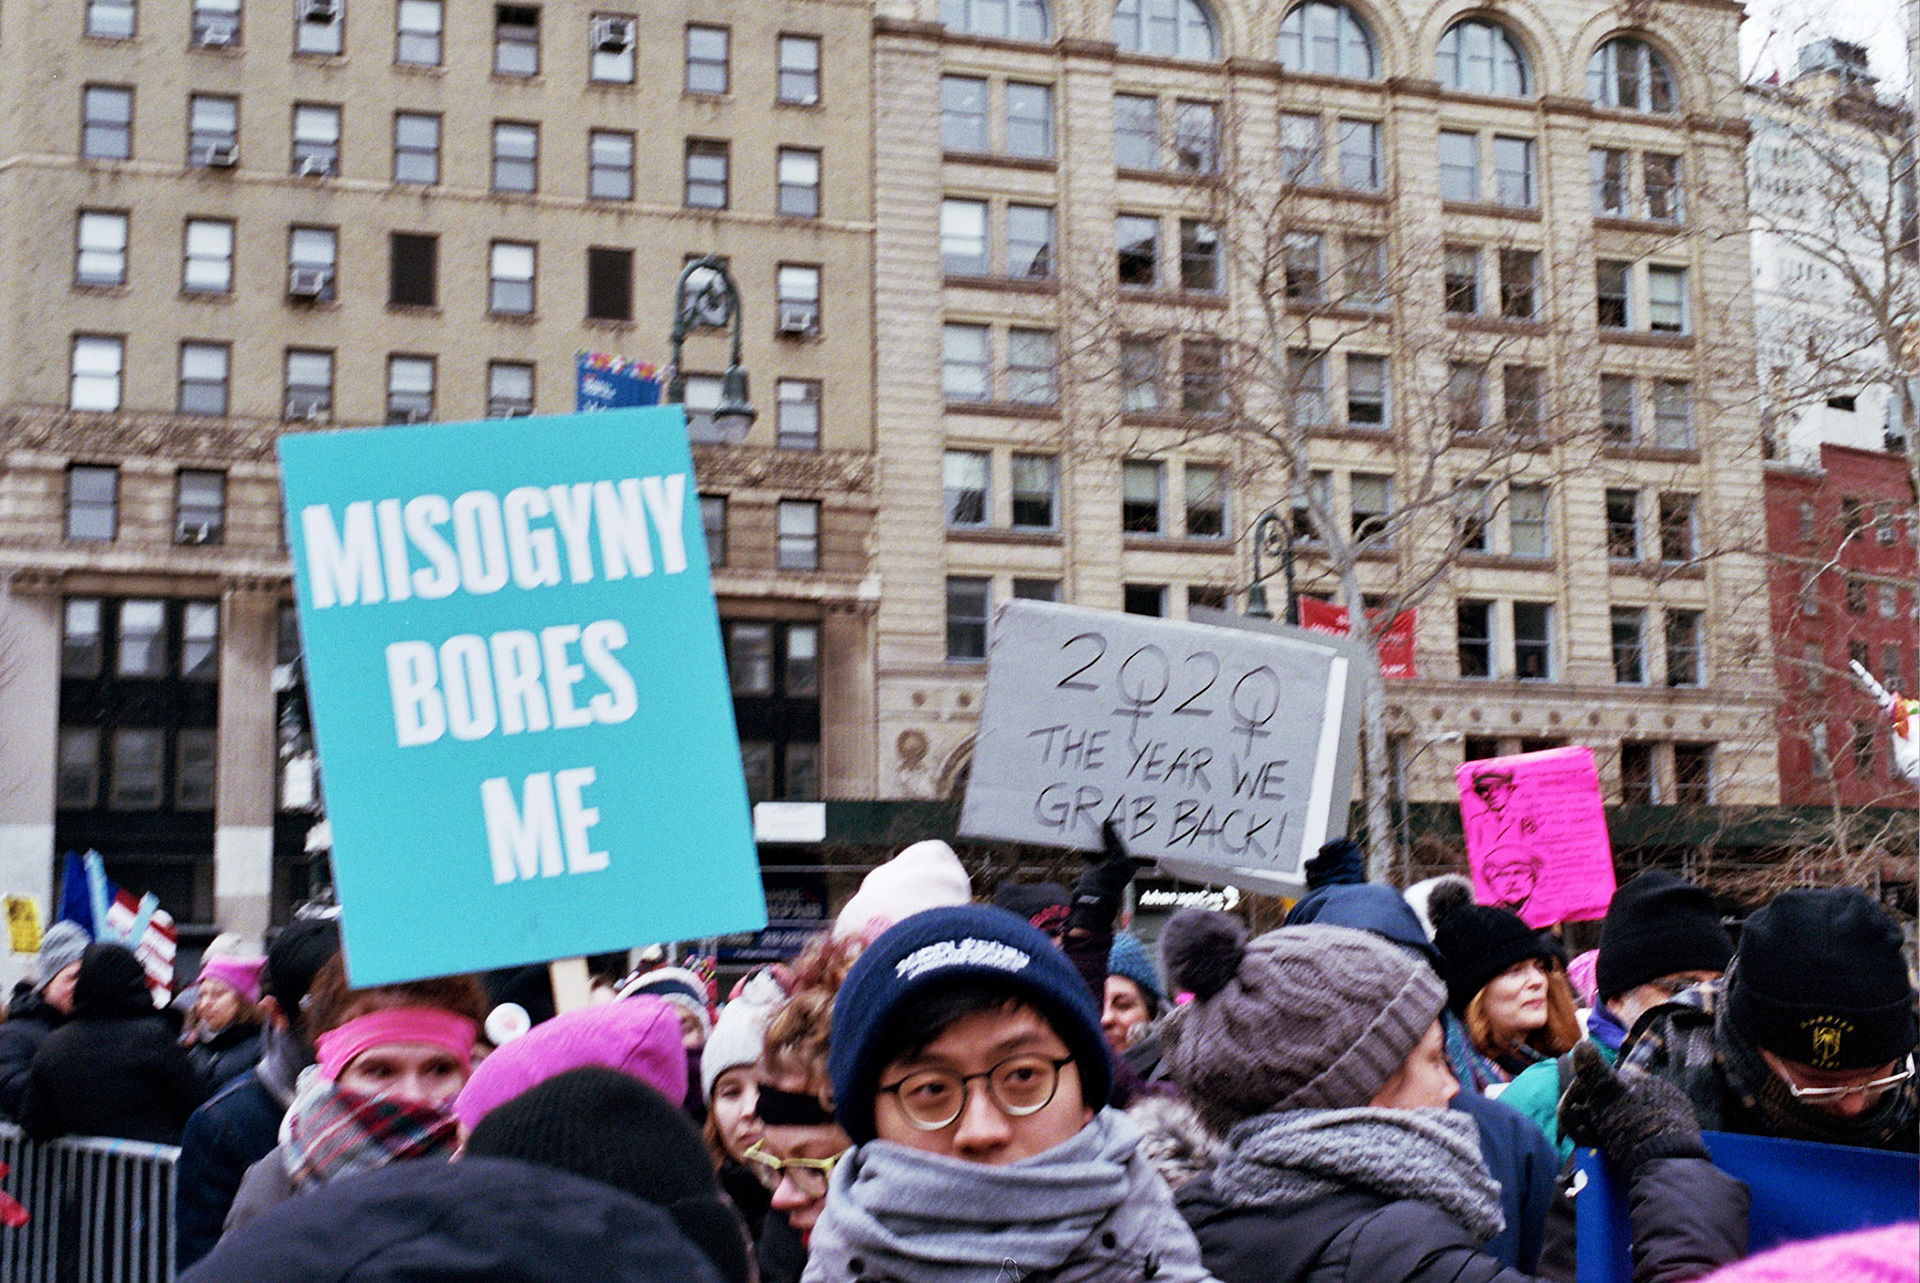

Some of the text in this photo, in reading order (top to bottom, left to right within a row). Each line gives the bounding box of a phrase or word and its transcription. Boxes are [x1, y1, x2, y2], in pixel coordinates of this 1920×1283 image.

[301, 473, 688, 609] MISOGYNY
[385, 619, 639, 748] BORES
[1056, 632, 1281, 748] 2020
[1027, 724, 1289, 800] THE YEAR WE
[481, 766, 610, 885] ME
[1033, 782, 1288, 861] GRAB BACK!
